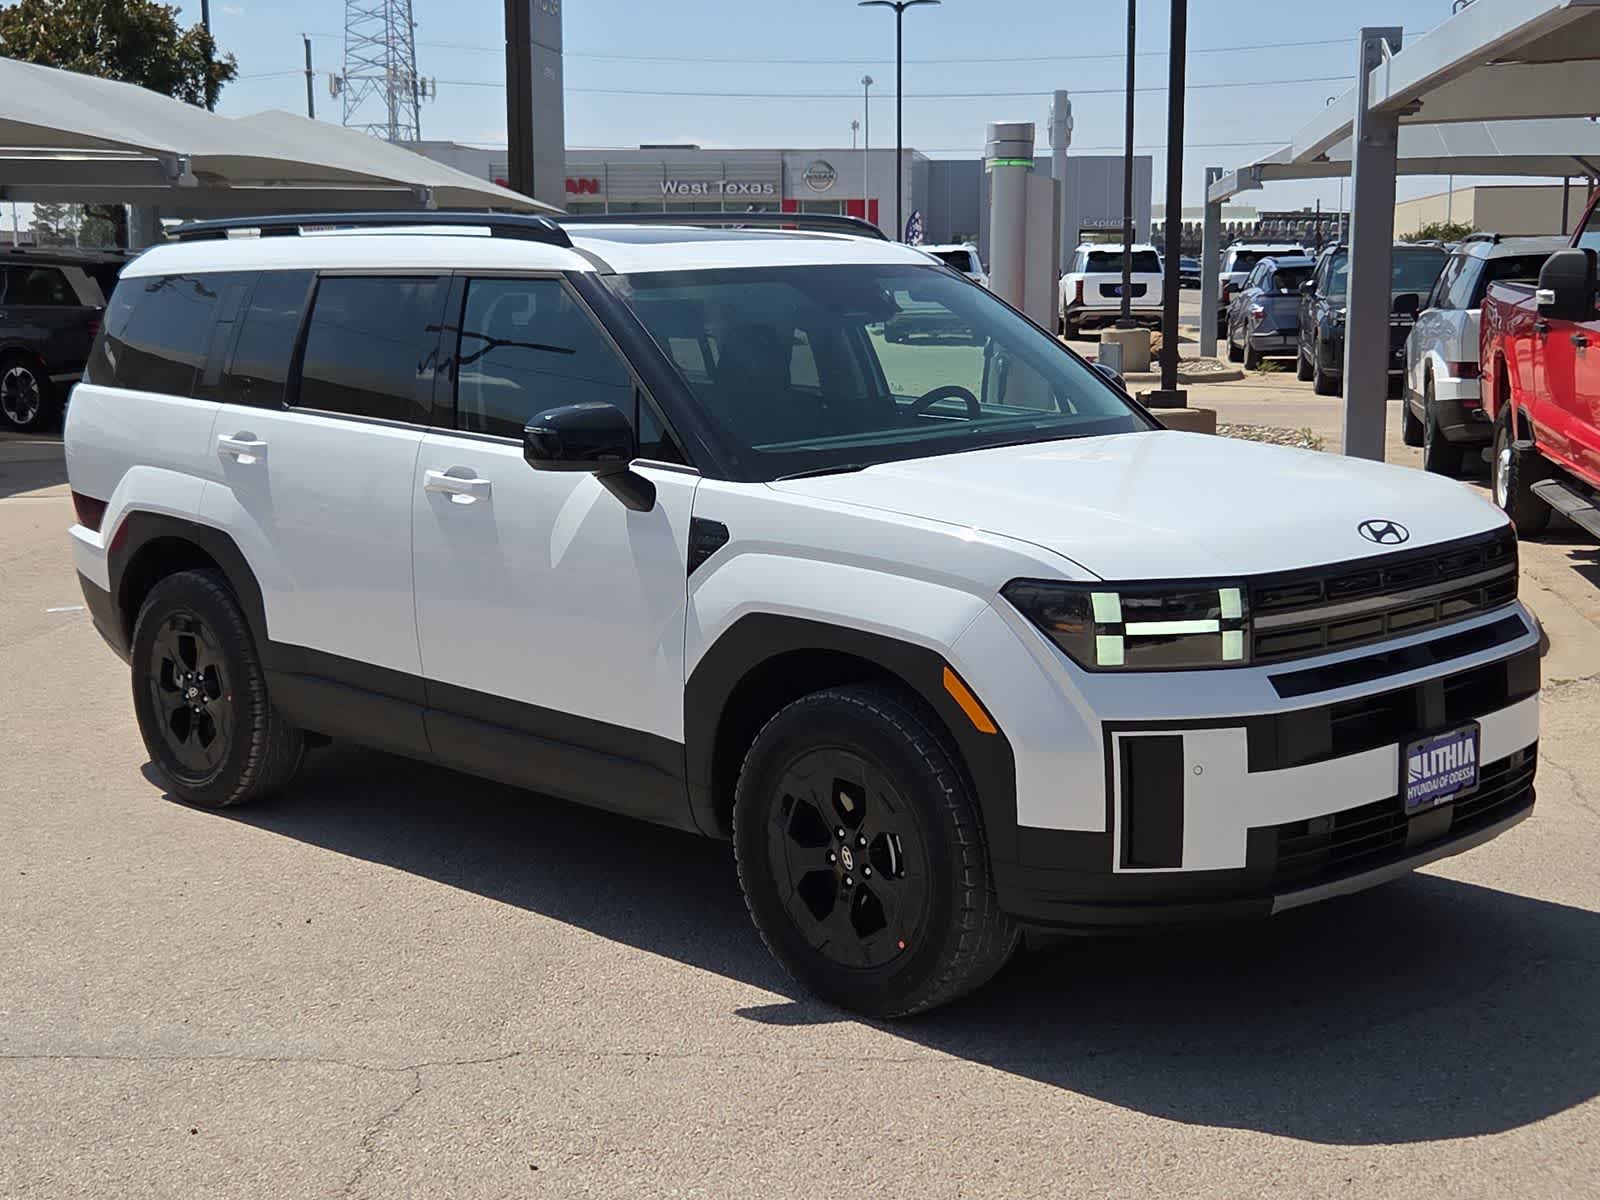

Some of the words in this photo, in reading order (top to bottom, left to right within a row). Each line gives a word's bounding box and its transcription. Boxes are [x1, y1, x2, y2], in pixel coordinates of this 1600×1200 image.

[660, 180, 708, 195] West
[716, 180, 775, 194] Texas
[1422, 738, 1475, 779] LITHIA
[1408, 779, 1439, 799] HYUNDAI
[1439, 774, 1449, 788] OF
[1449, 765, 1475, 784] ODESSA
